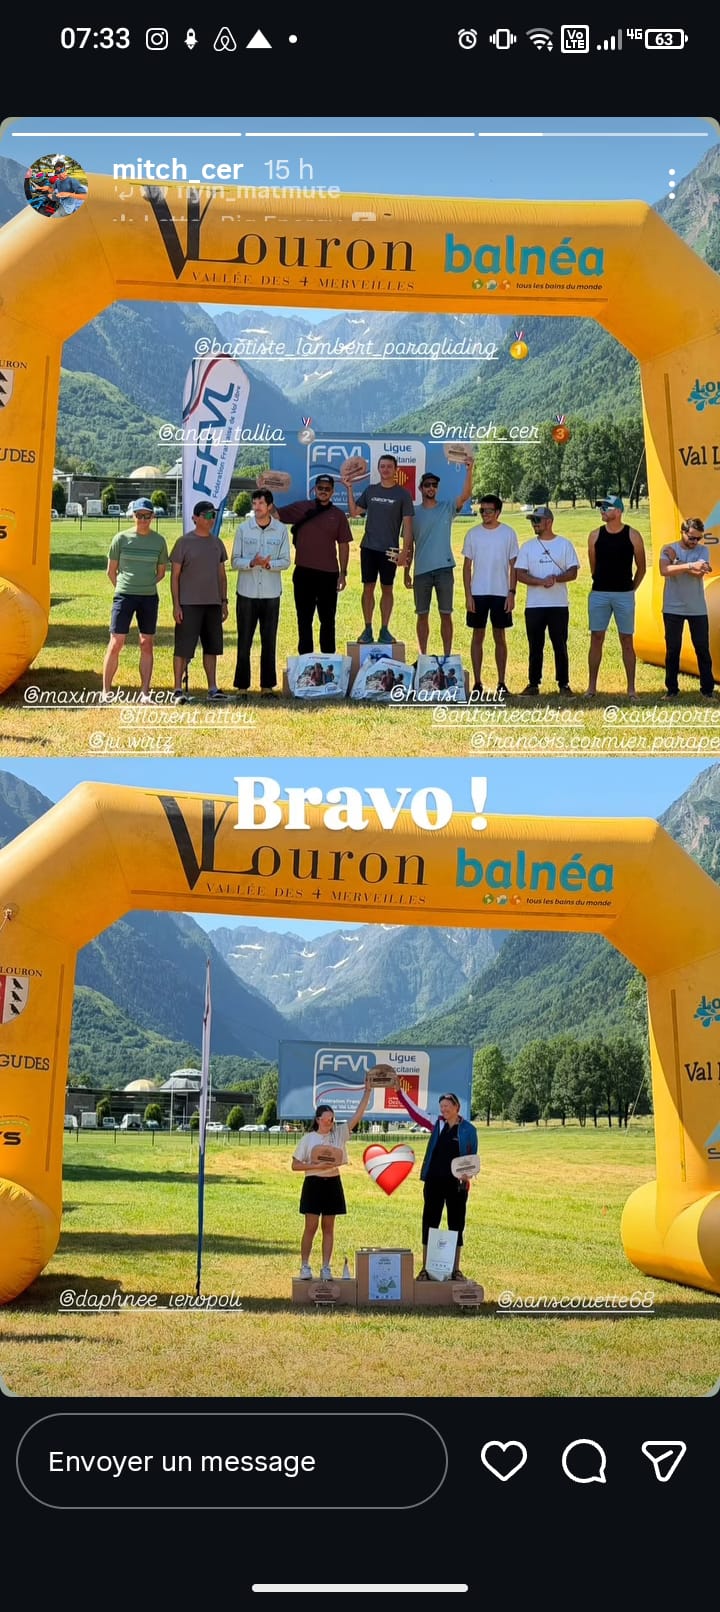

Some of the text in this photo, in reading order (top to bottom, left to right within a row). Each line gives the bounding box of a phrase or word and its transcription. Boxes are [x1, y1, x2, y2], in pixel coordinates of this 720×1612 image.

[60, 27, 131, 49] 07:33
[565, 39, 585, 49] LTE
[566, 29, 584, 40] Vo
[626, 28, 643, 40] 4G
[655, 33, 673, 46] 63
[444, 232, 606, 276] balnéa
[192, 271, 415, 291] VALLÉE DES 4 MERVEILLES
[192, 382, 235, 497] FFVL
[383, 442, 412, 454] Ligue
[678, 445, 707, 466] Val
[455, 847, 614, 893] balnéa
[206, 882, 427, 904] VALLÉE DES 4 MERVEILLES
[319, 1054, 371, 1072] FFVL
[388, 1052, 416, 1064] Ligue
[684, 1061, 713, 1082] Val
[0, 1130, 21, 1146] S
[49, 1451, 316, 1478] Envoyer un message
